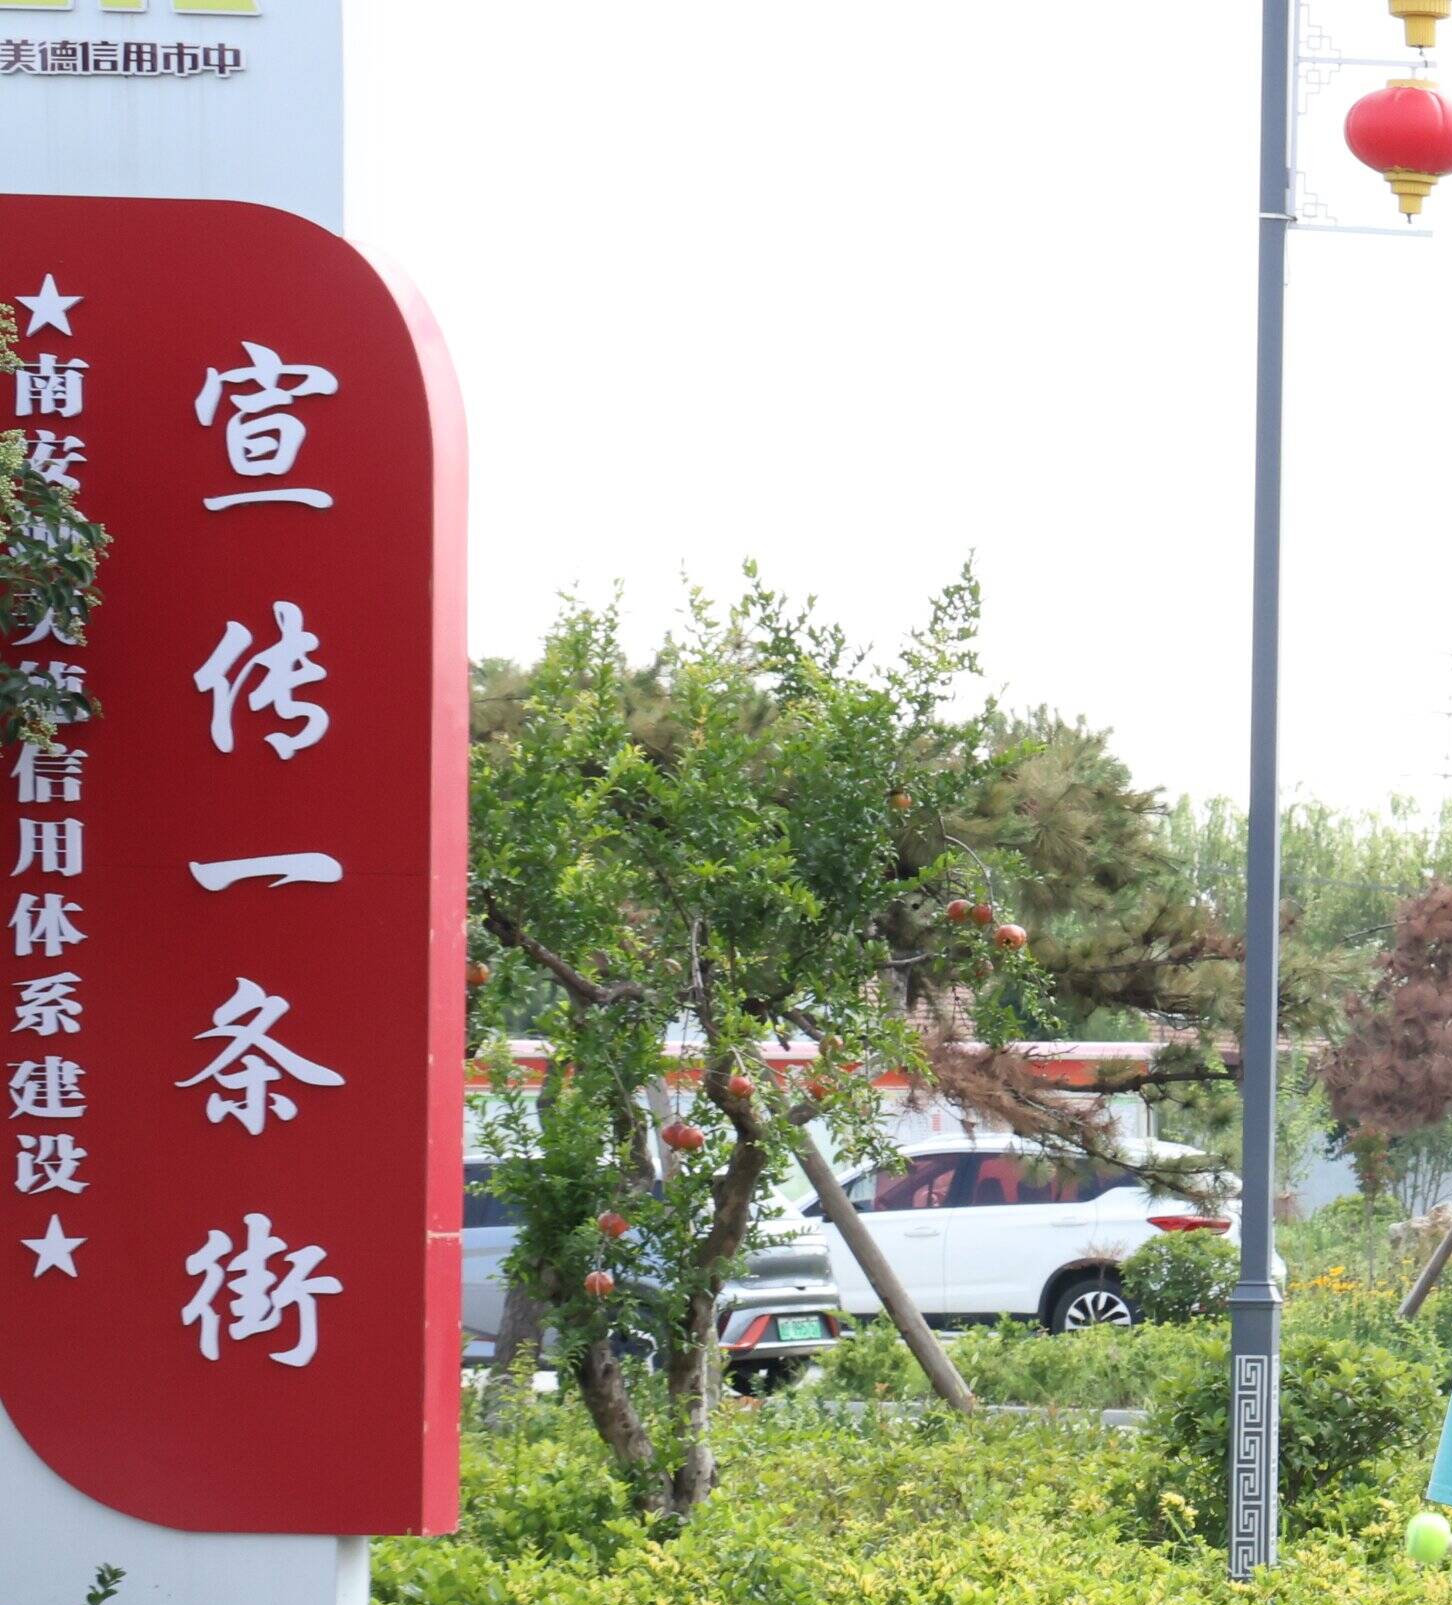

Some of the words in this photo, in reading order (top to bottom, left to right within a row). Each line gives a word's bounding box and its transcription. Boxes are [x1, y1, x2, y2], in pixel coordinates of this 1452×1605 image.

[174, 340, 345, 1368] 宣传一条街
